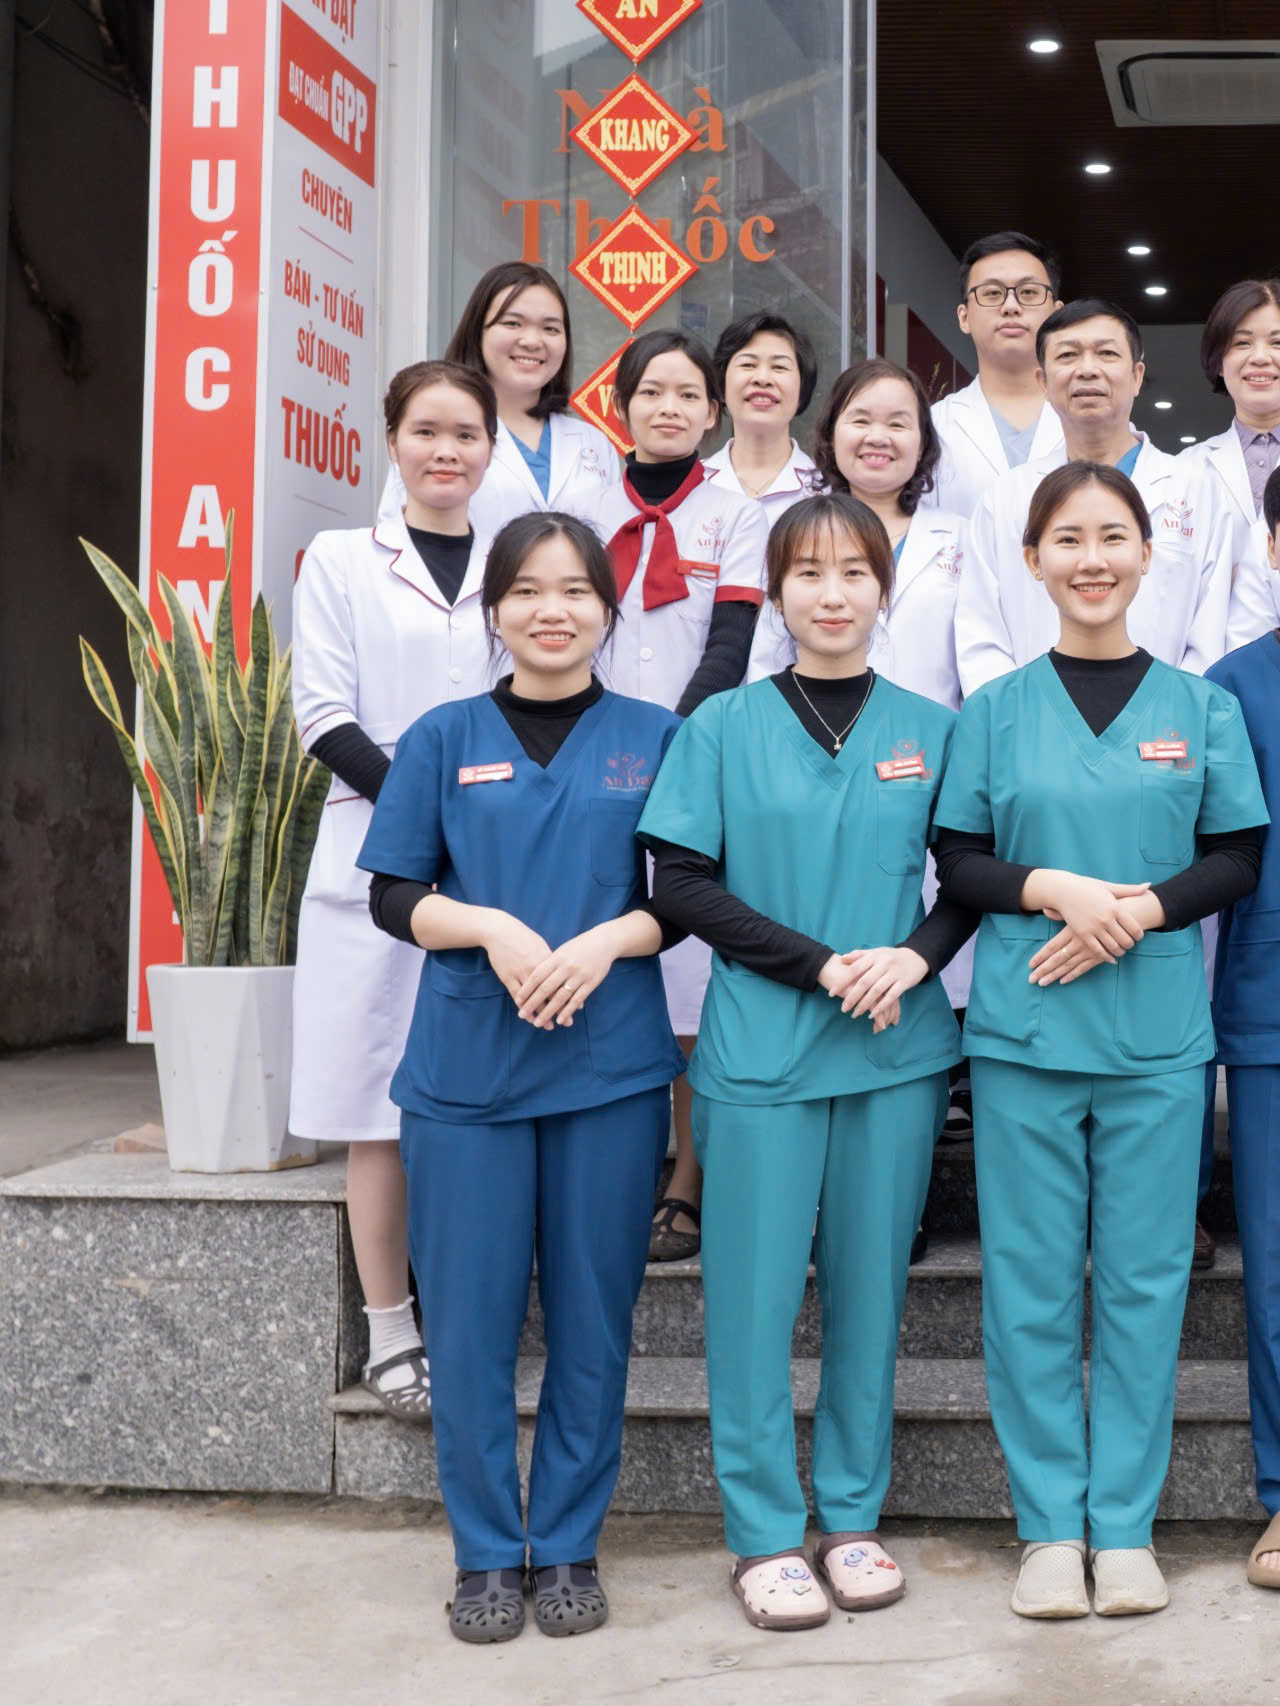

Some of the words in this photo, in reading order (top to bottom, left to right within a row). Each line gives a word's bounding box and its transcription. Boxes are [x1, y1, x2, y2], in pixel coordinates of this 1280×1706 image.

[331, 69, 368, 154] GPP
[600, 118, 670, 152] KHANG
[301, 168, 353, 234] CHUYÊN
[285, 258, 312, 308] BÁN
[323, 283, 340, 323] TƯ
[341, 289, 364, 339] VẤN
[599, 251, 668, 293] THỊNH
[297, 320, 316, 368] SỬ
[317, 338, 350, 387] DỤNG
[281, 396, 361, 488] THUỐC
